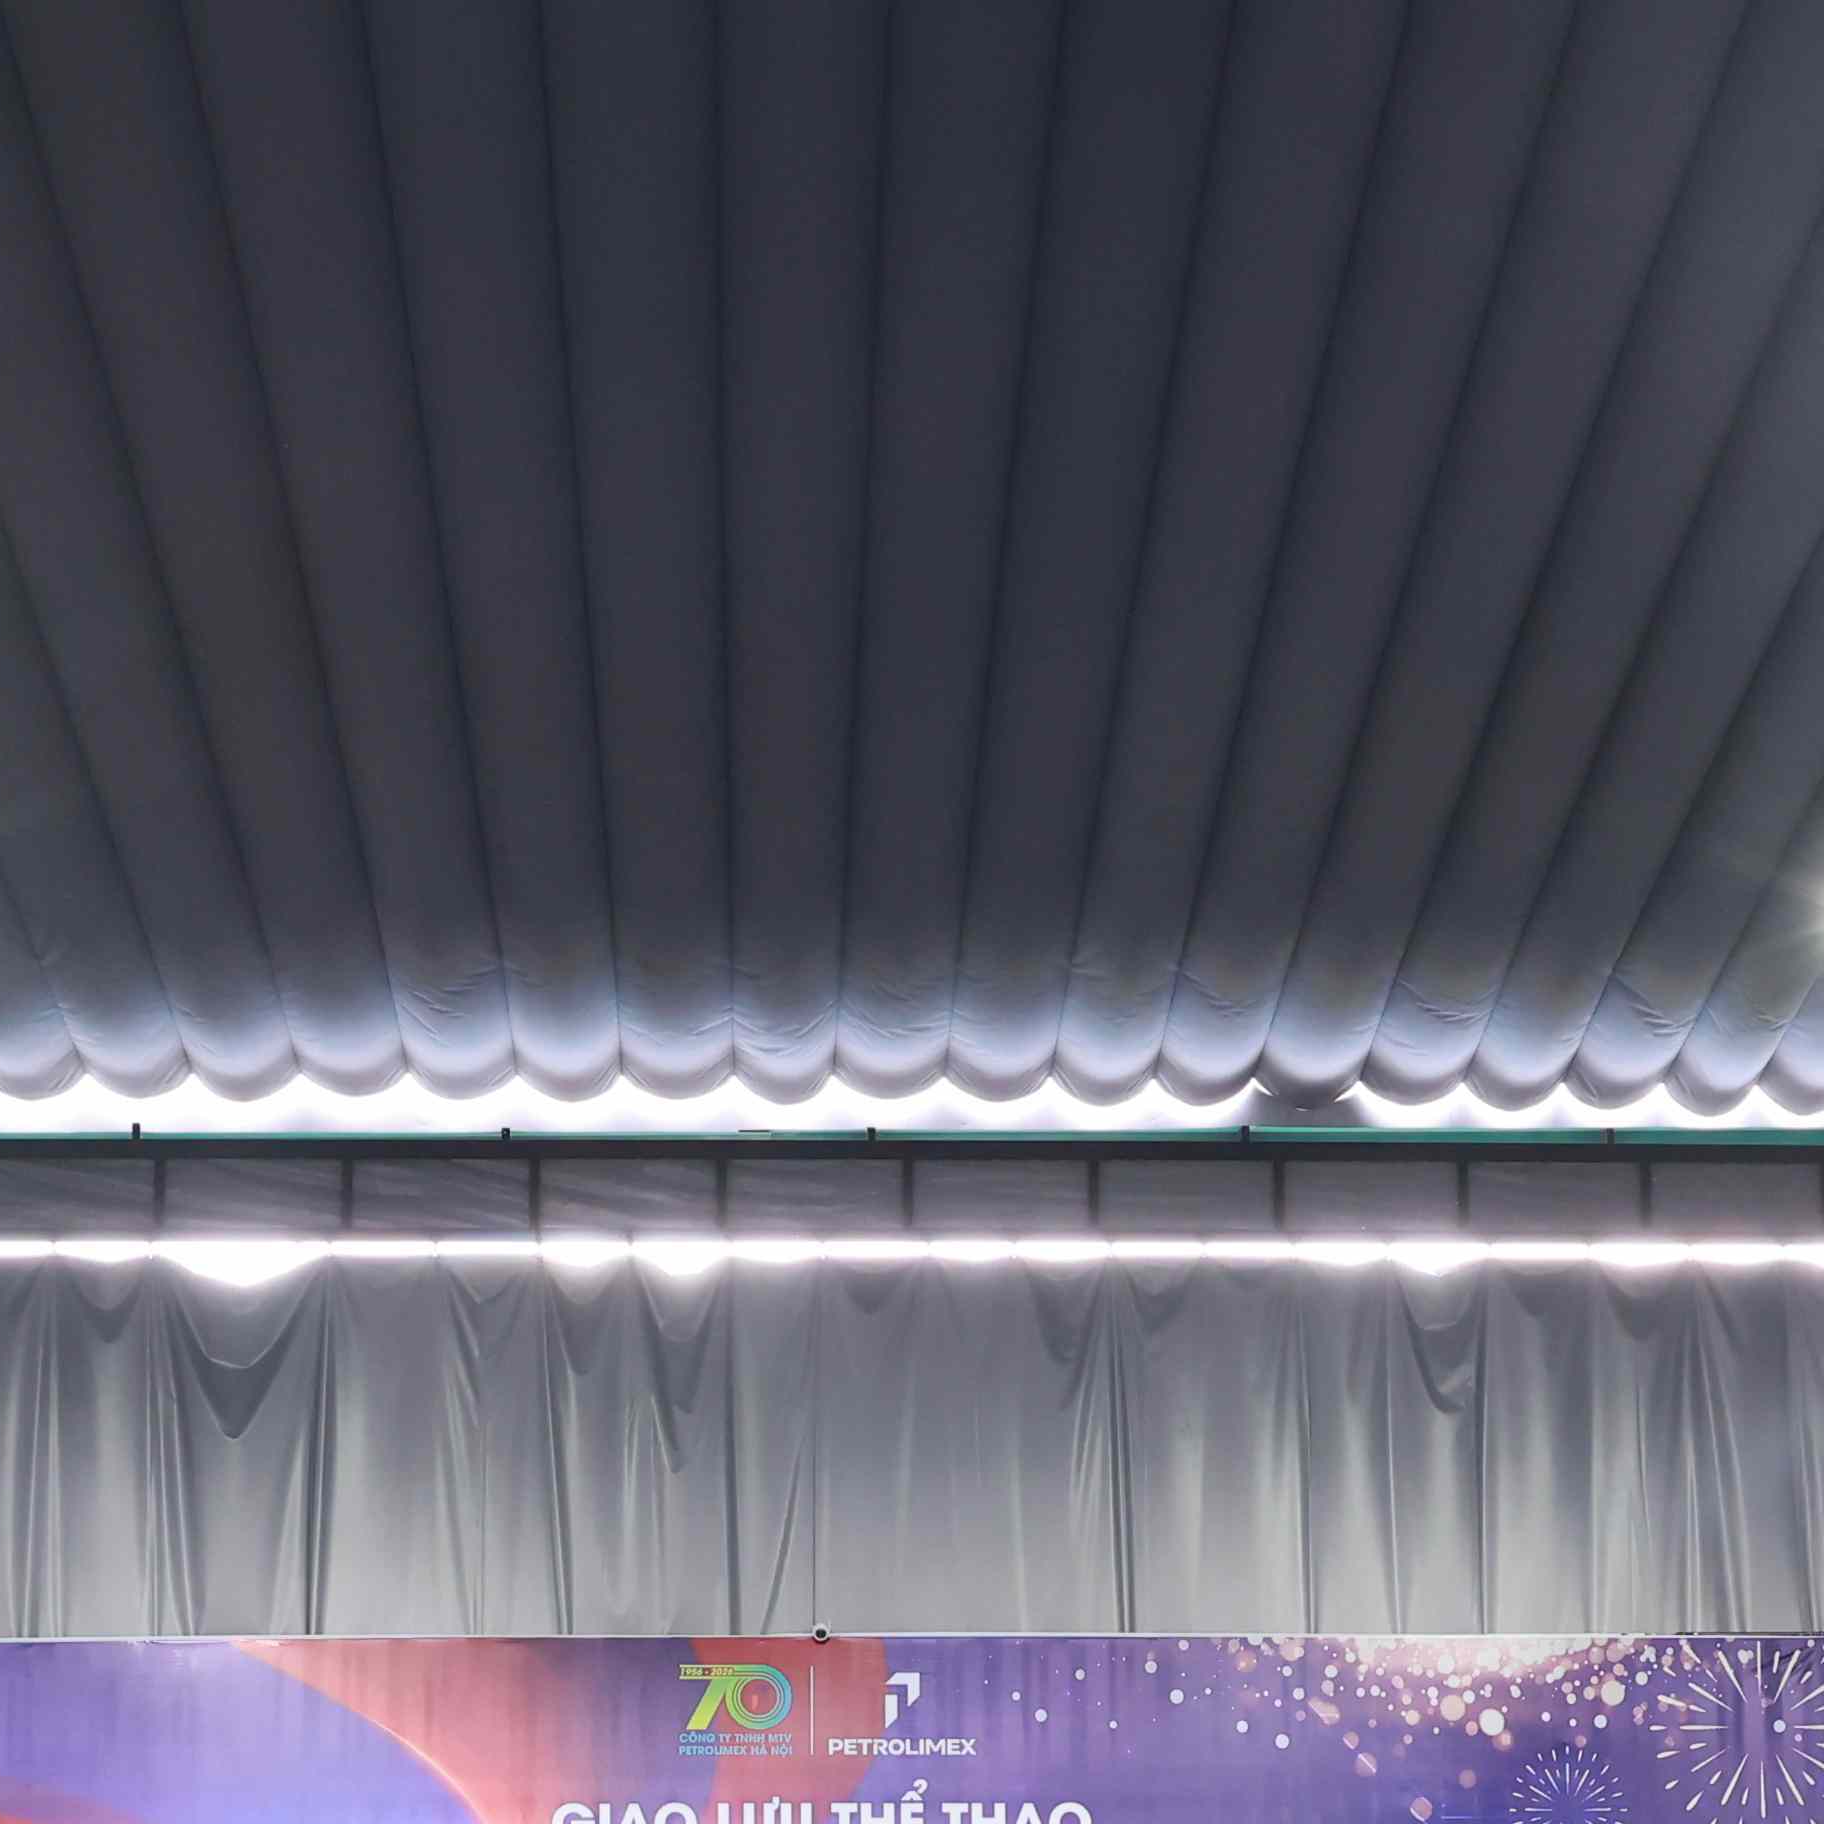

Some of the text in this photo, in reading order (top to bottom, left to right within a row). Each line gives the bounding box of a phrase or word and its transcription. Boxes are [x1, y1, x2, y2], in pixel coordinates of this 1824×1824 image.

[679, 1664, 793, 1731] 70
[679, 1731, 793, 1744] CÔNG TY TNHH MTV
[679, 1745, 747, 1756] PETROLIMEX
[827, 1738, 977, 1756] PETROLIMEX
